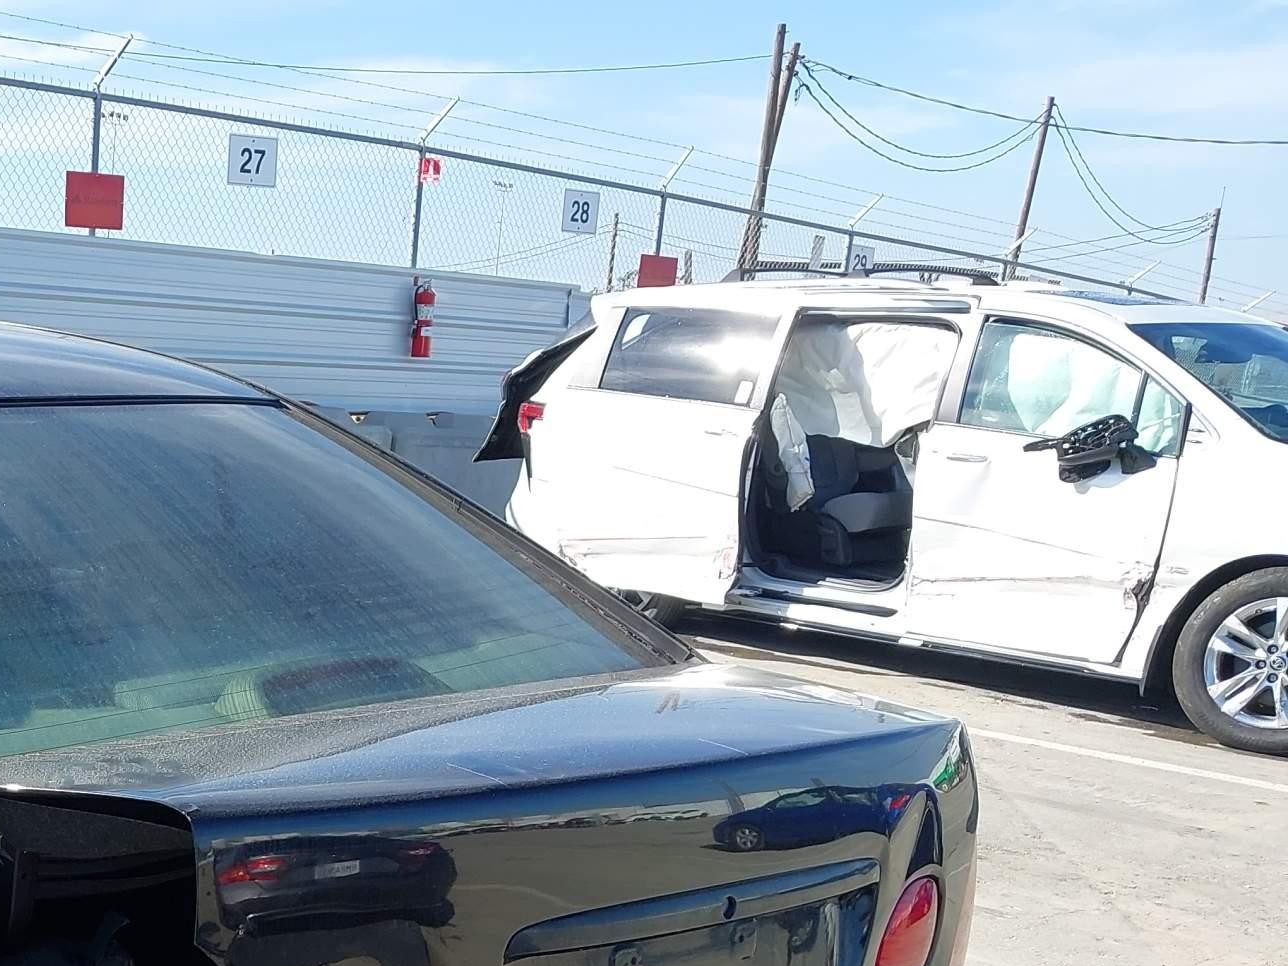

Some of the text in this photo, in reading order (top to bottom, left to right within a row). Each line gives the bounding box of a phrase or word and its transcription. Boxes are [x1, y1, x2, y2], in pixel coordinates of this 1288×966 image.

[239, 147, 266, 175] 27
[570, 200, 590, 224] 28
[852, 253, 868, 271] 29
